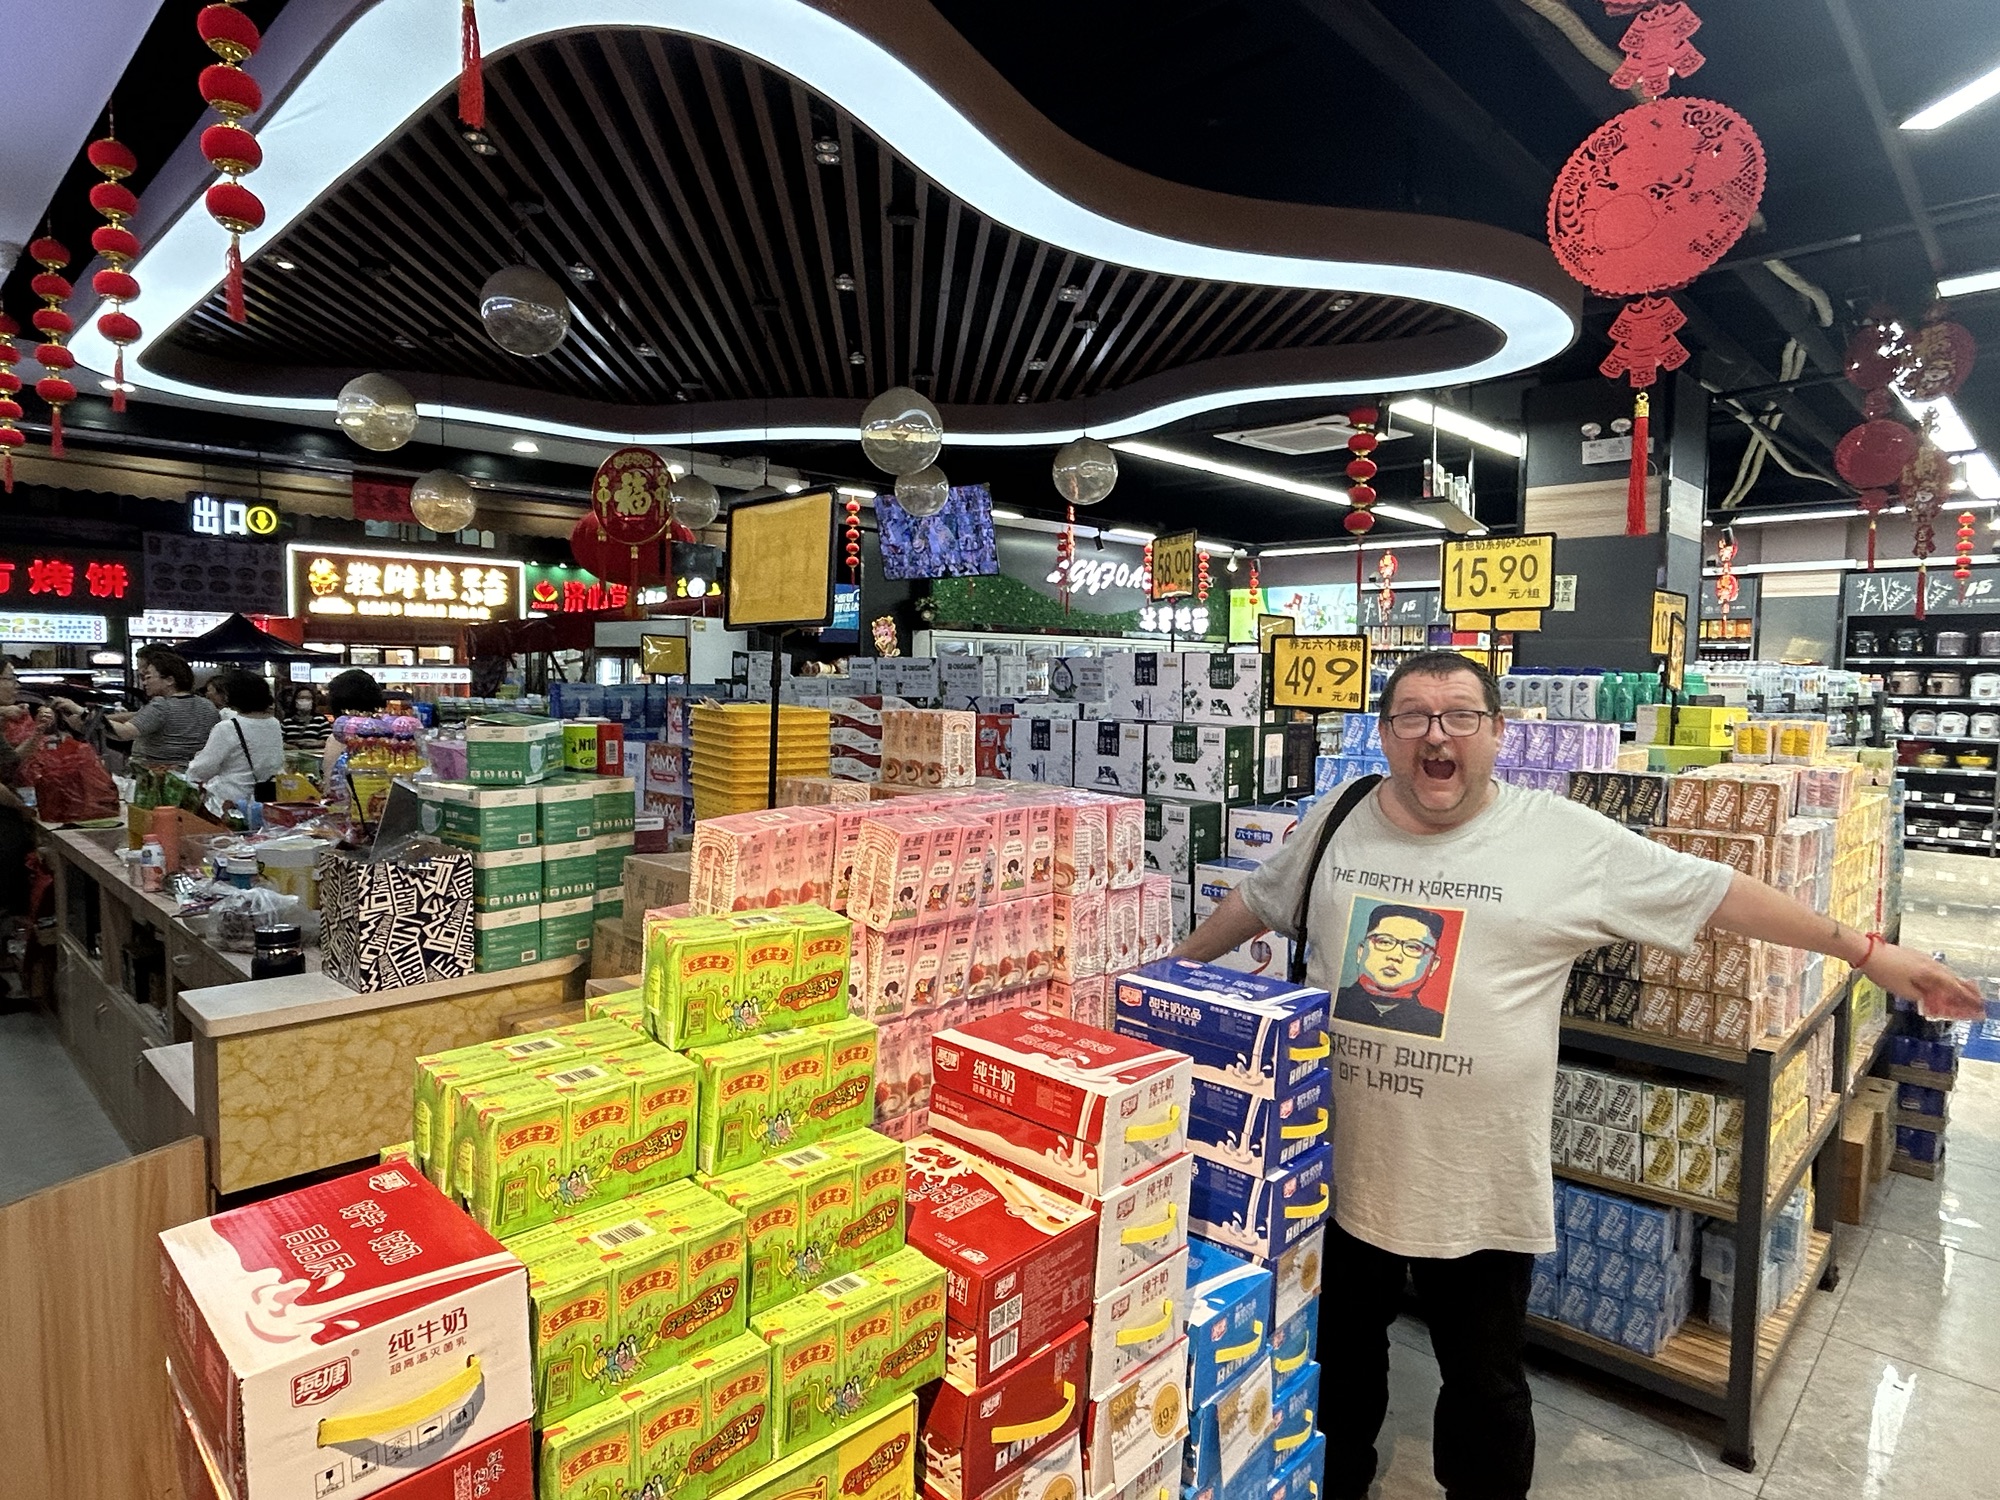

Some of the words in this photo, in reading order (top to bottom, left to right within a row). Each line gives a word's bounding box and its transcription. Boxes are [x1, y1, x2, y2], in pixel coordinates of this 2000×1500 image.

[192, 496, 248, 535] 出口
[1157, 548, 1192, 588] 58.00
[1452, 554, 1539, 598] 15.90
[1284, 656, 1360, 697] 49.9
[1331, 691, 1360, 703] 元/箱
[652, 753, 678, 773] AMX
[1236, 828, 1273, 843] 六个核桃
[1333, 866, 1355, 883] THE
[1358, 870, 1413, 893] NORTH
[1418, 879, 1502, 903] KOREANS
[755, 947, 786, 963] 王老吉
[811, 939, 844, 955] 王老吉
[692, 956, 727, 970] 王老吉
[1149, 996, 1202, 1021] 甜牛奶饮品
[839, 1046, 867, 1063] 王老吉
[1394, 1046, 1473, 1077] BUNCH
[787, 1059, 818, 1077] 王老吉
[973, 1058, 1017, 1093] 纯牛奶
[1339, 1062, 1360, 1084] OF
[1366, 1068, 1425, 1099] LADS
[730, 1075, 762, 1092] 王老吉
[1148, 1074, 1175, 1099] 纯牛奶
[650, 1091, 684, 1109] 王老吉
[584, 1107, 620, 1128] 王老吉
[510, 1127, 551, 1148] 王老吉
[867, 1167, 895, 1189] 王老吉
[1146, 1172, 1173, 1197] 纯牛奶
[811, 1188, 848, 1209] 王老吉
[756, 1209, 790, 1230] 王老吉
[699, 1242, 732, 1267] 王老吉
[630, 1271, 668, 1296] 王老吉
[1142, 1268, 1169, 1295] 纯牛奶
[555, 1301, 596, 1324] 王老吉
[907, 1294, 936, 1317] 王老吉
[388, 1307, 469, 1357] 纯牛奶
[852, 1318, 886, 1341] 王老吉
[389, 1338, 468, 1377] 超高温灭菌乳
[793, 1344, 828, 1368] 王老吉
[295, 1363, 348, 1402] 燕塘
[722, 1375, 758, 1401] 王老吉
[652, 1407, 692, 1438] 王老吉
[574, 1444, 617, 1474] 王老吉
